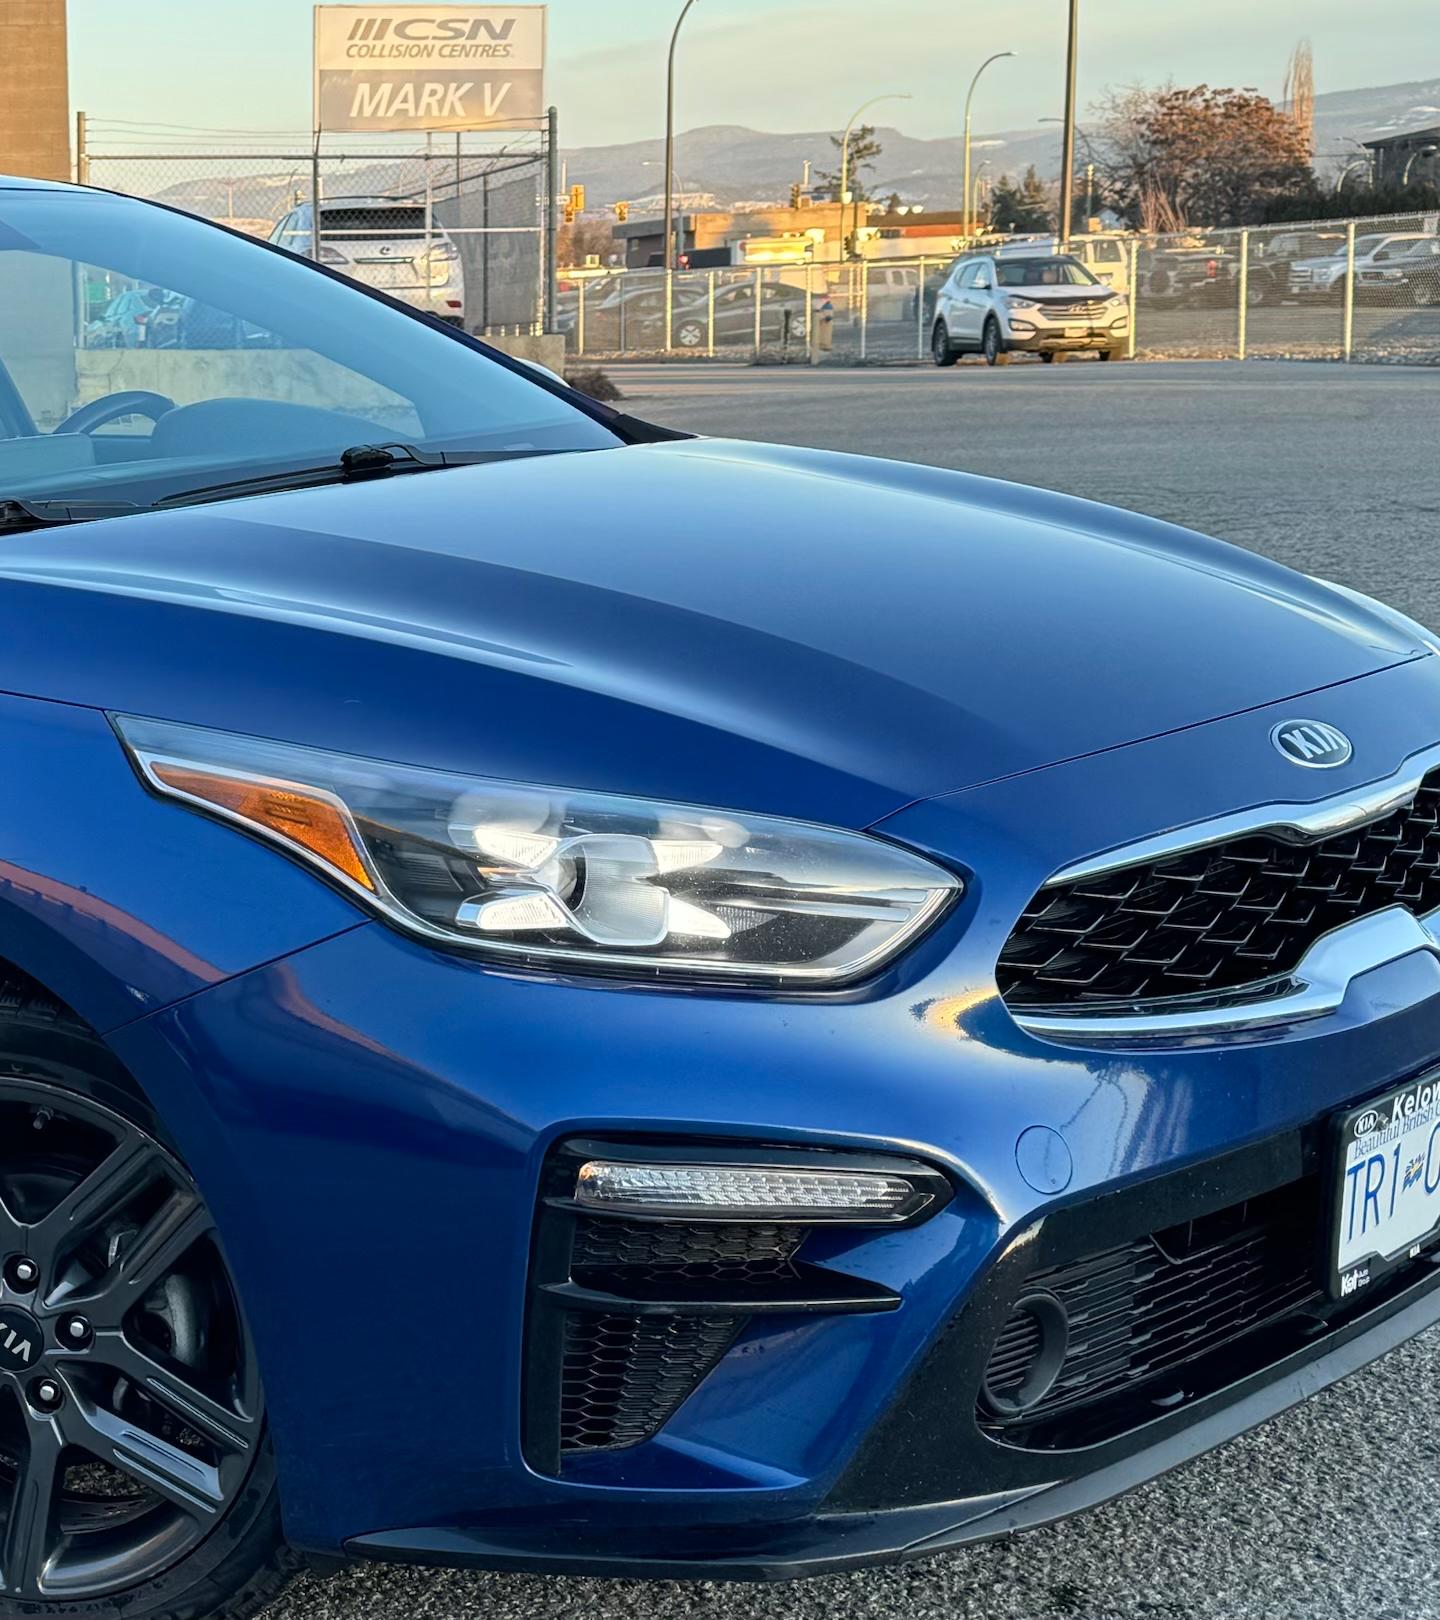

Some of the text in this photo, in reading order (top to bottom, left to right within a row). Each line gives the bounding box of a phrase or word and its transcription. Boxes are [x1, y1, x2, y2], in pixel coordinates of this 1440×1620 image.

[393, 18, 516, 41] CSN
[346, 43, 513, 58] COLLISION CENTRES
[349, 82, 513, 118] MARK V
[1281, 724, 1348, 759] KIA
[1354, 1120, 1400, 1160] Beautiful
[1347, 1142, 1402, 1244] TR1
